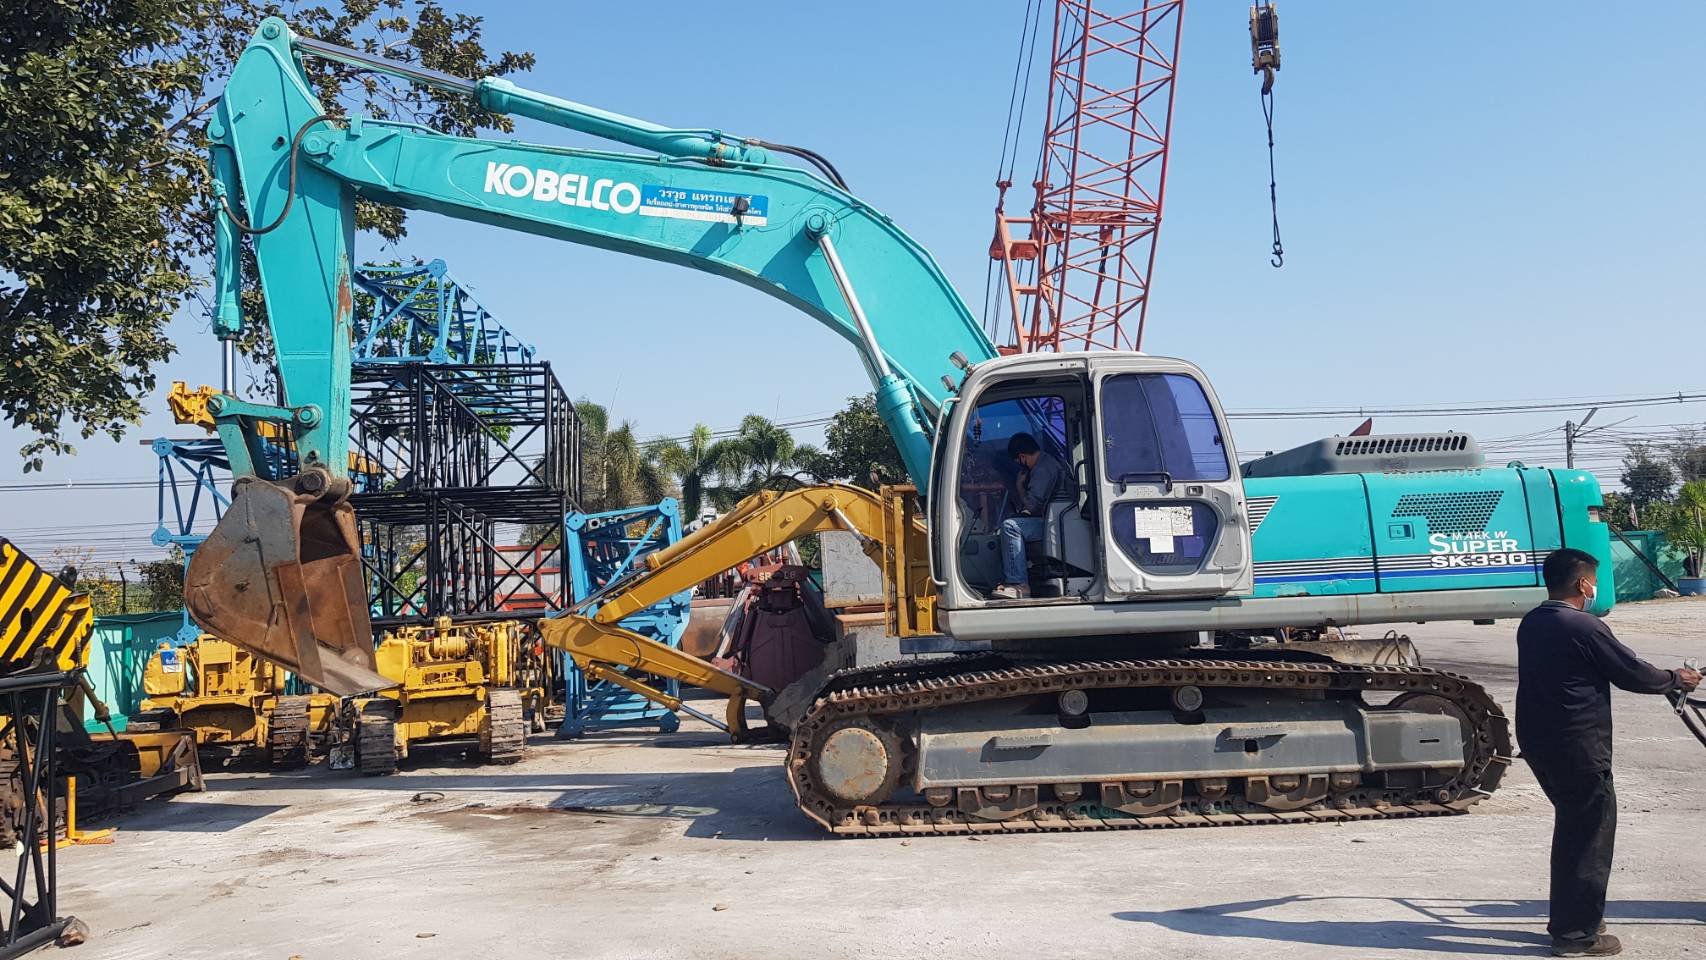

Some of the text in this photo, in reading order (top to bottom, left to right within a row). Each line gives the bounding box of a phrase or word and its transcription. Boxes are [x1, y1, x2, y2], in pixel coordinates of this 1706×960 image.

[484, 161, 641, 214] KOBELCO
[692, 193, 752, 206] แทรกเตร์
[1429, 532, 1518, 554] SUPER
[1452, 531, 1491, 541] MARK
